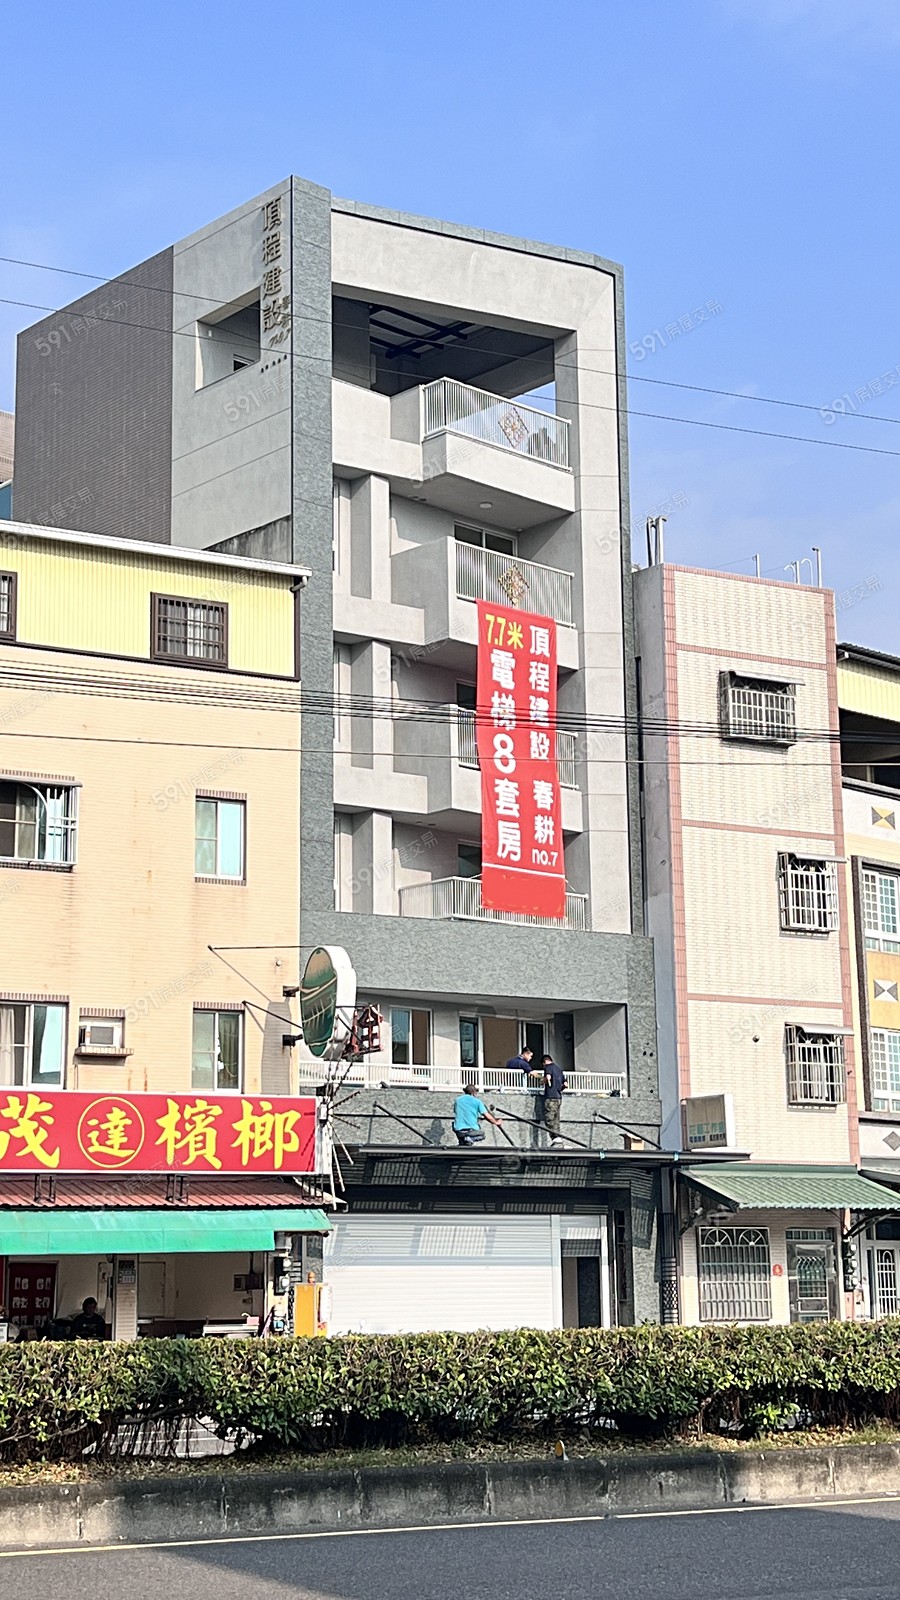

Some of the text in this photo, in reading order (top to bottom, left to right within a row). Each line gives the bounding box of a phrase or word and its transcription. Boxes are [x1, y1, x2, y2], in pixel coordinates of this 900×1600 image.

[262, 197, 282, 333] 頂程建設
[485, 613, 523, 649] 7.7米
[490, 648, 521, 862] 電梯8套房
[529, 625, 558, 867] 頂程建設 春耕 no.7
[0, 1093, 301, 1169] 茂達檳榔
